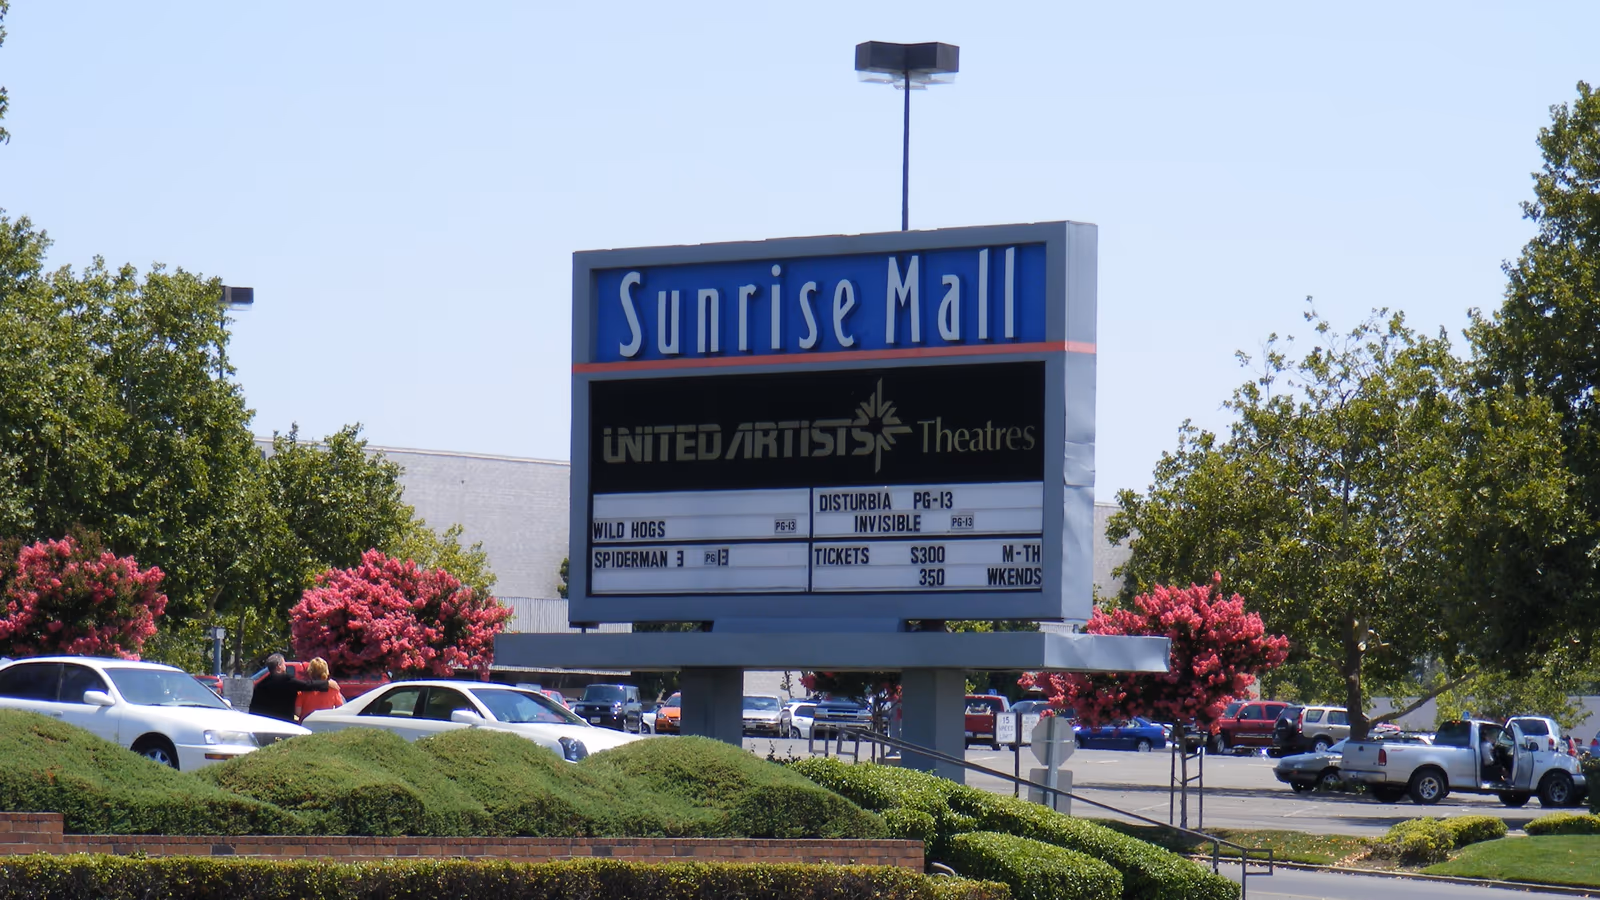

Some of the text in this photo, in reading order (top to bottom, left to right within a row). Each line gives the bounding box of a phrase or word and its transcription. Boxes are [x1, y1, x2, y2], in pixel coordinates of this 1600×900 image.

[619, 247, 1015, 358] Sunrise Mall
[603, 416, 1036, 463] UNITED ARTISTS Theatres
[819, 491, 953, 512] DISTURBIA PG-13
[593, 521, 666, 540] WILD HOGS
[775, 521, 796, 531] PG-13
[854, 514, 922, 533] INVISIBLE
[951, 516, 974, 528] PG-13
[594, 551, 668, 569] SPIDERMAN
[815, 547, 870, 566] TICKETS
[1002, 544, 1042, 564] M-TH
[918, 567, 1043, 587] 350 WKENDS
[1002, 716, 1010, 724] 15
